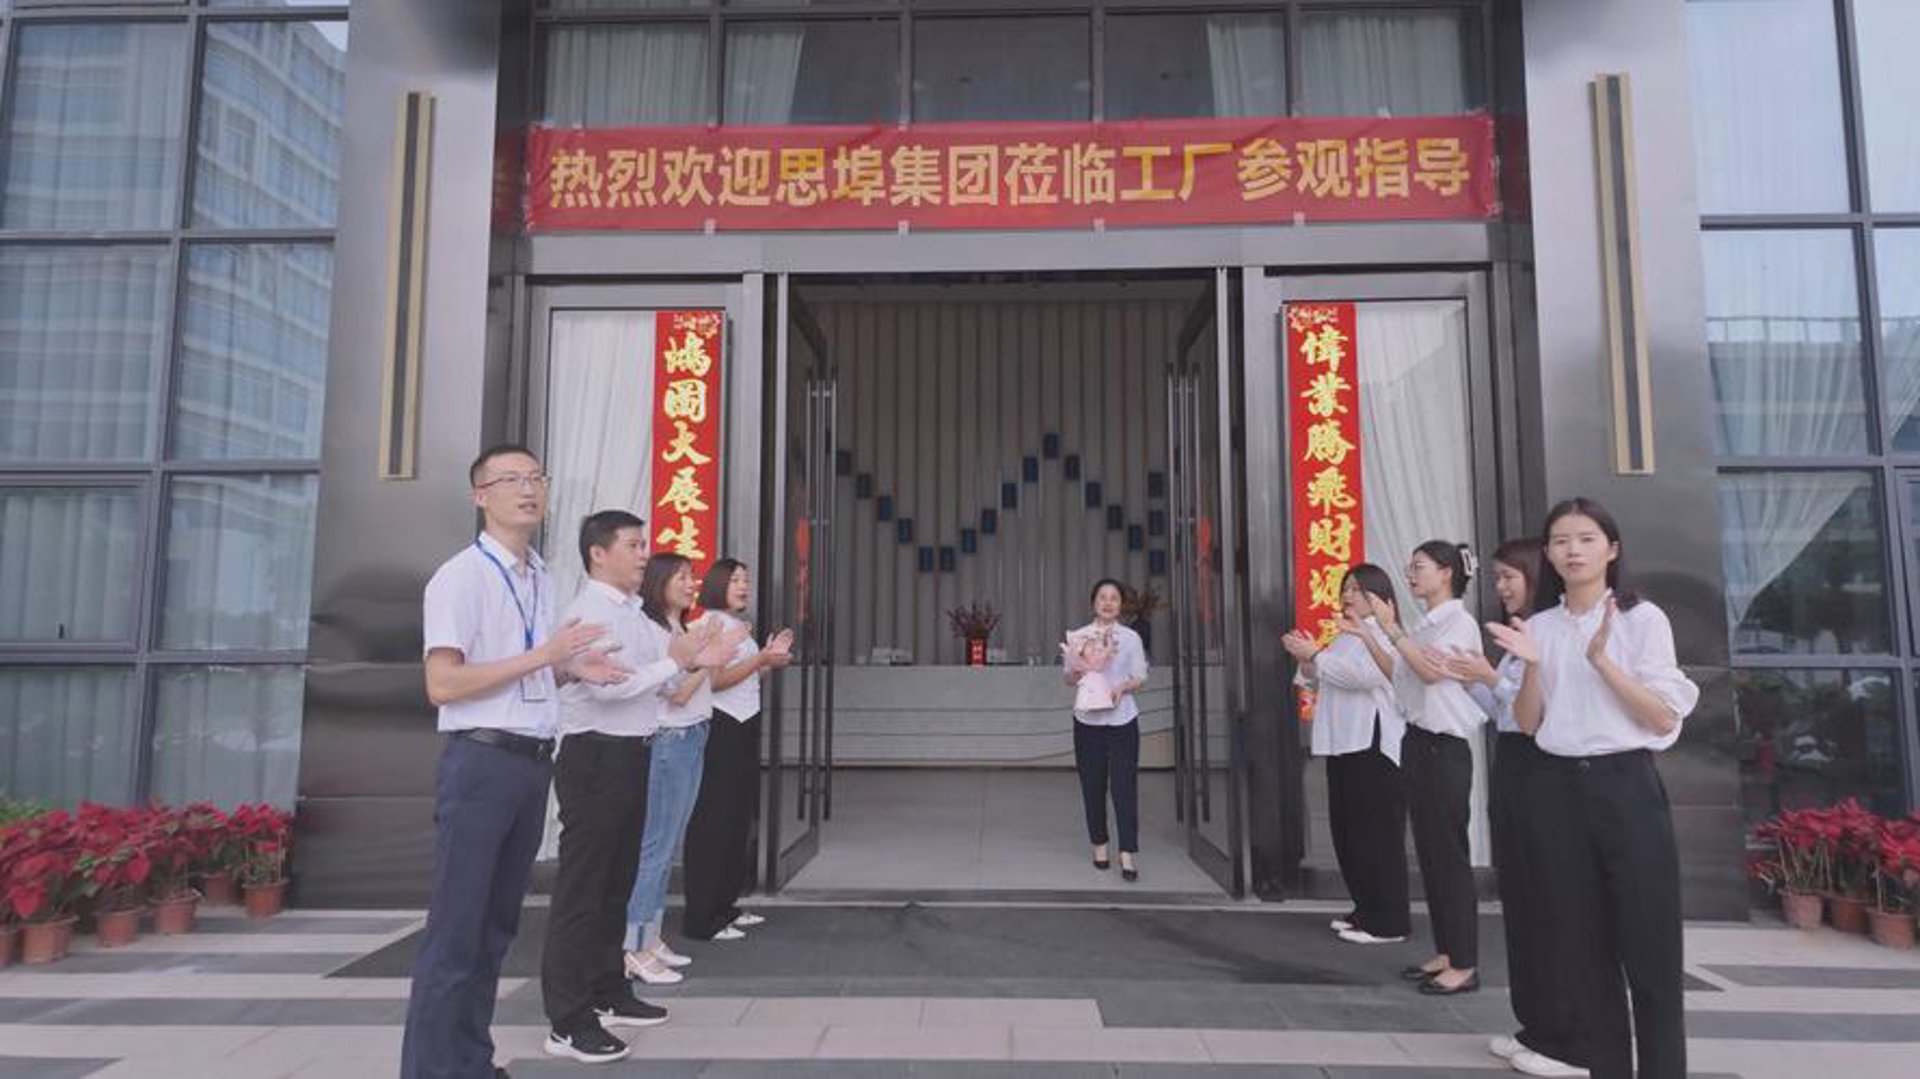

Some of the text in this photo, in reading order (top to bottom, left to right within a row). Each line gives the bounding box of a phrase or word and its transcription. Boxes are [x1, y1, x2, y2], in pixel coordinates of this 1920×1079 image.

[550, 137, 1470, 208] 热烈欢迎思埠集团莅临工厂参观指导
